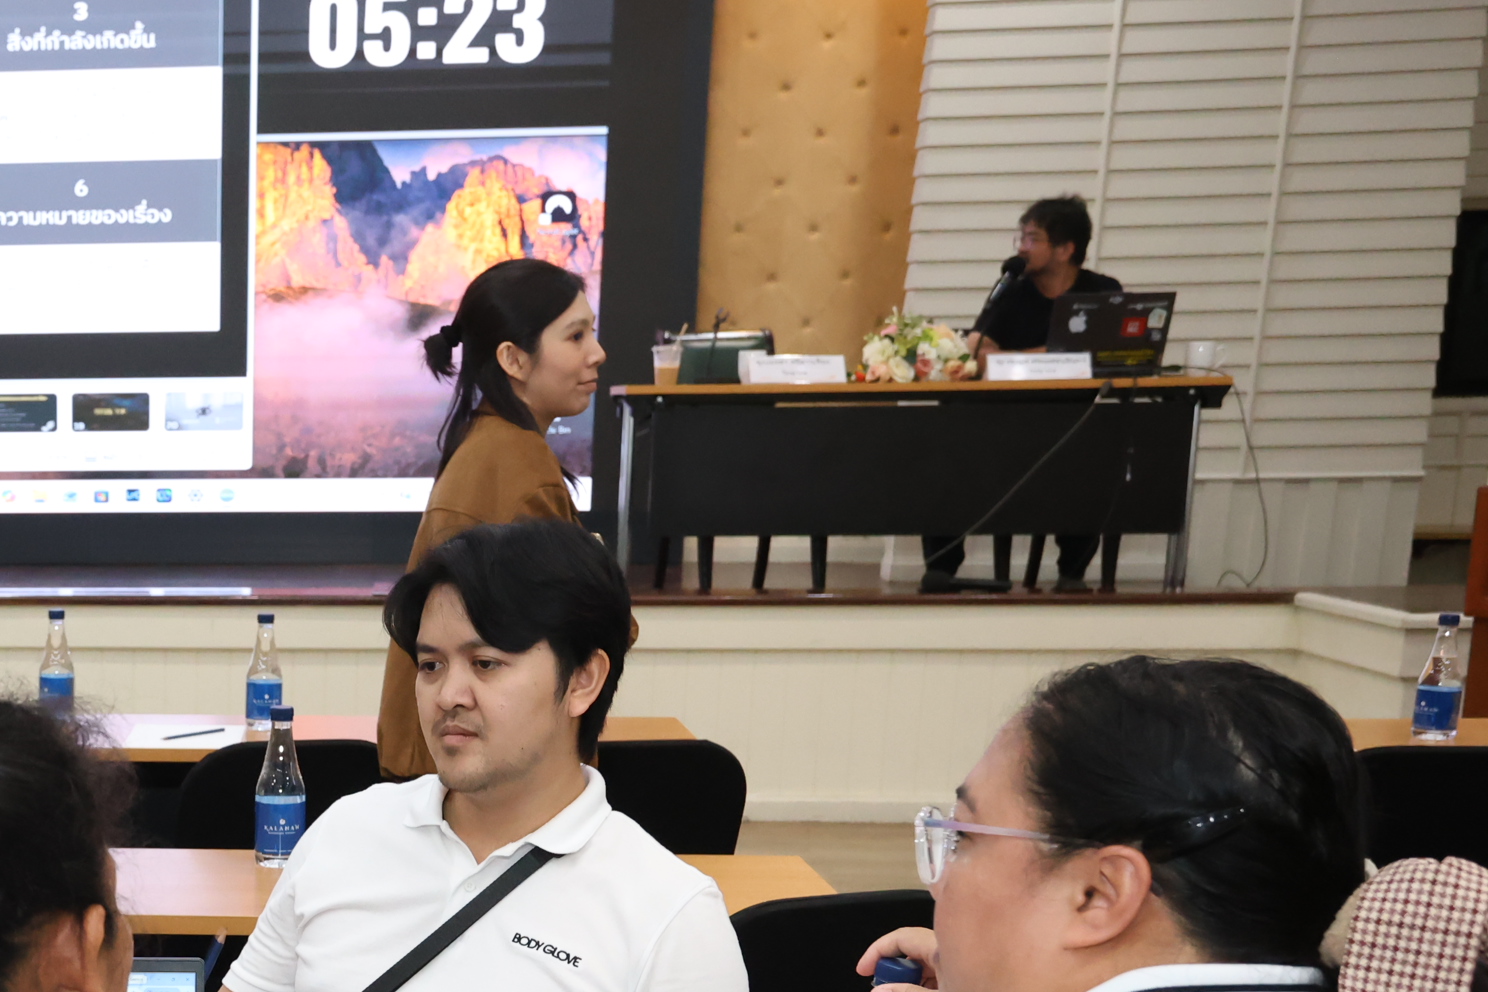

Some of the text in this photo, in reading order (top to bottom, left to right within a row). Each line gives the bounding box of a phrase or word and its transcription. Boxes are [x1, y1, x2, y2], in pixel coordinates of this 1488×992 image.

[72, 1, 89, 21] 3
[6, 20, 157, 52] สิ่งที่กำลังเกิดขึ้น
[308, 0, 546, 69] 05:23
[73, 178, 89, 198] 6
[511, 932, 582, 968] BODY GLOVE
